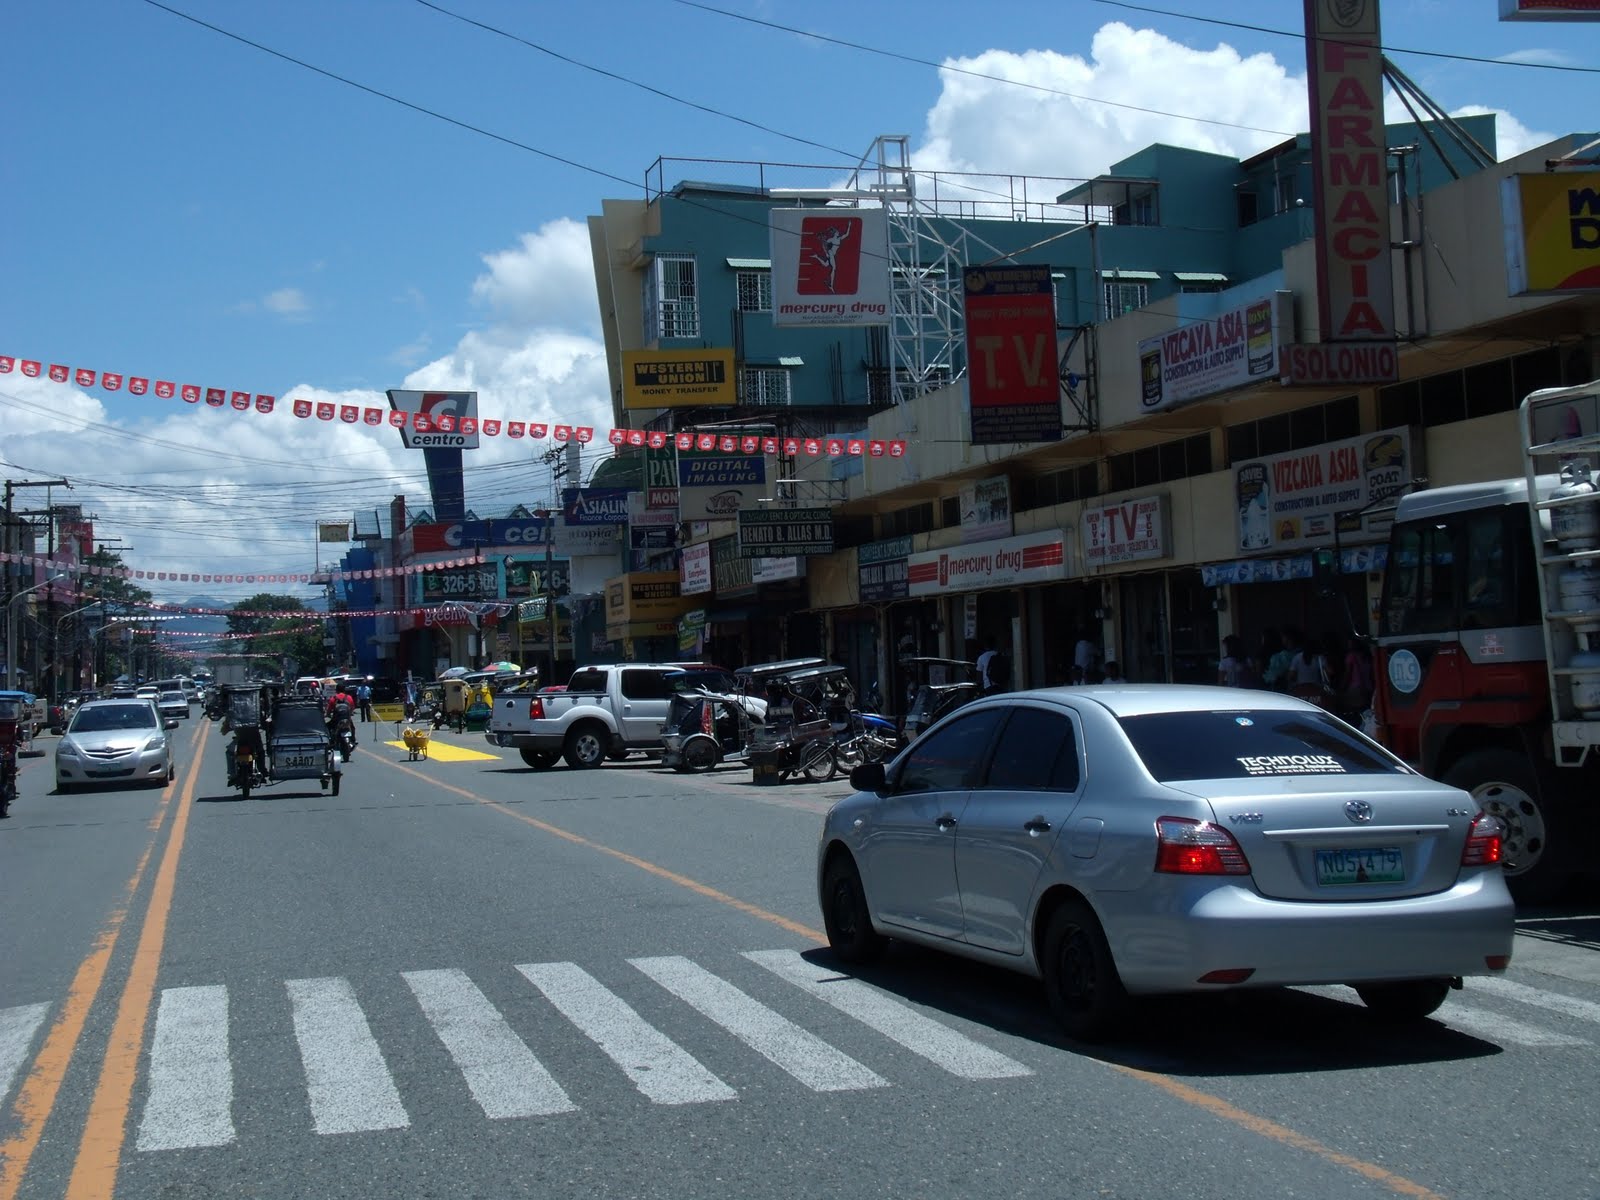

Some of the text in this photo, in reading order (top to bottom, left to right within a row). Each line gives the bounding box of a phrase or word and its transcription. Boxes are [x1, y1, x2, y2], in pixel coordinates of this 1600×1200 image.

[1324, 40, 1386, 335] FARMACIA
[780, 302, 886, 316] mercury drug
[1162, 311, 1245, 366] VIZCAYA ASIA
[636, 362, 705, 375] WESTERN
[1163, 357, 1203, 384] CONSTRUCTION
[1209, 352, 1225, 370] AUTO
[1225, 344, 1245, 364] SUPPLY
[1293, 347, 1394, 380] SOLONIO
[658, 373, 705, 384] UNION
[642, 387, 719, 396] MONEY TRANSFER
[413, 434, 465, 446] centro
[691, 461, 751, 472] DIGITAL
[1272, 446, 1361, 495] VIZCAYA ASIA
[687, 473, 757, 484] IMAGING
[1369, 470, 1399, 488] COAT
[1274, 497, 1314, 513] CONSTRUCTION
[1321, 493, 1337, 506] AUTO
[1338, 488, 1361, 504] SUPPLY
[580, 513, 602, 522] Finance
[1104, 503, 1139, 544] TV
[742, 526, 774, 543] RENATO
[787, 525, 812, 541] ALLAS
[814, 525, 832, 541] M.D.
[949, 549, 1021, 576] mercury drug
[632, 583, 671, 592] WESTERN
[644, 590, 671, 599] UNION
[1236, 755, 1341, 767] TECHNOLUX
